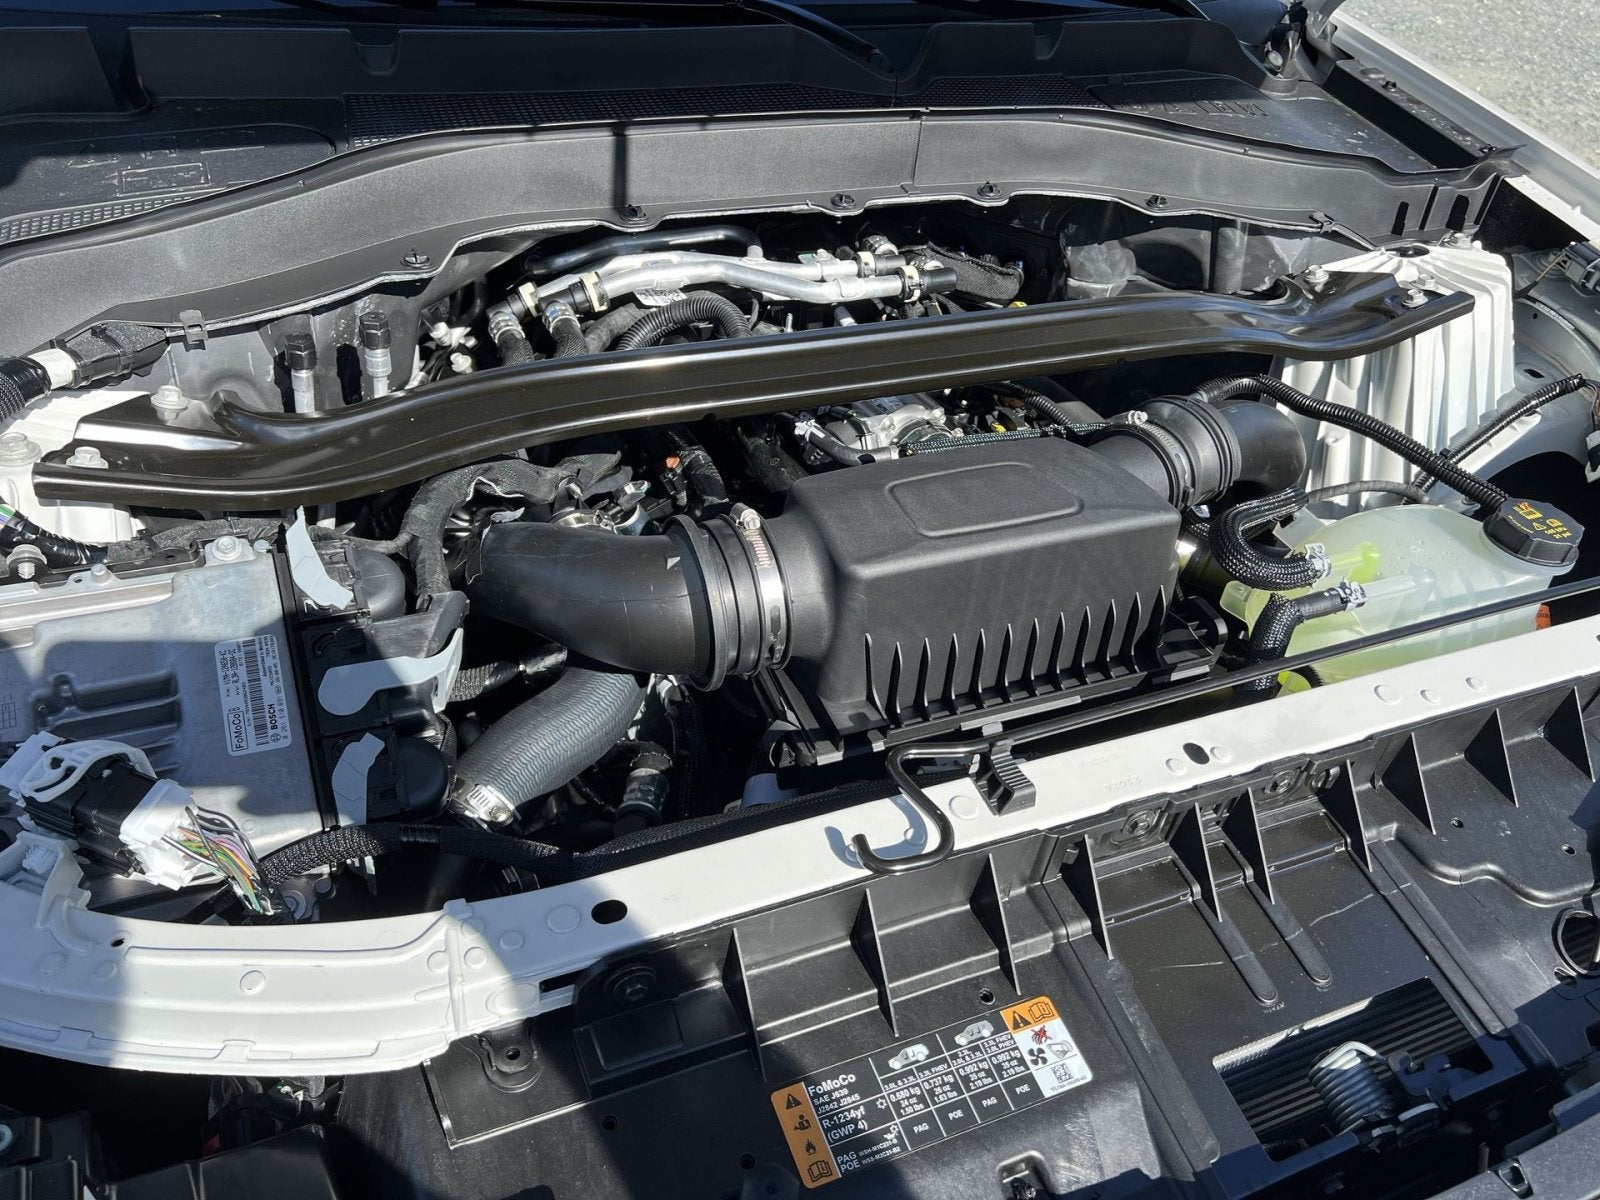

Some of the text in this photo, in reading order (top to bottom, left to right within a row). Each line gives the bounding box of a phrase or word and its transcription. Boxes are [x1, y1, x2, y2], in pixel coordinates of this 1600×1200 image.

[268, 703, 278, 730] BOSCH
[231, 713, 245, 749] FoMoCo
[990, 1048, 1021, 1064] 0.992 kg
[930, 1063, 948, 1073] FHEV
[958, 1059, 989, 1076] 0.992 kg
[1001, 1061, 1010, 1069] 35
[1013, 1063, 1025, 1073] lbs
[922, 1072, 954, 1090] 0.737 kg
[968, 1072, 978, 1081] 35
[981, 1075, 993, 1085] lbs
[807, 1071, 856, 1096] FoMoCo
[942, 1084, 951, 1092] oz
[1014, 1083, 1030, 1094] POE
[908, 1084, 921, 1097] kg
[946, 1089, 958, 1098] lbs
[812, 1094, 830, 1105] SAE
[899, 1096, 917, 1107] 24 oz
[981, 1095, 997, 1107] PAG
[900, 1101, 924, 1115] 1.50 lbs
[947, 1108, 963, 1120] POE
[821, 1105, 867, 1130] R-1234yf
[826, 1118, 869, 1143] (GWP 4)
[912, 1121, 929, 1134] PAG
[836, 1150, 857, 1164] PAG
[839, 1158, 860, 1173] POE
